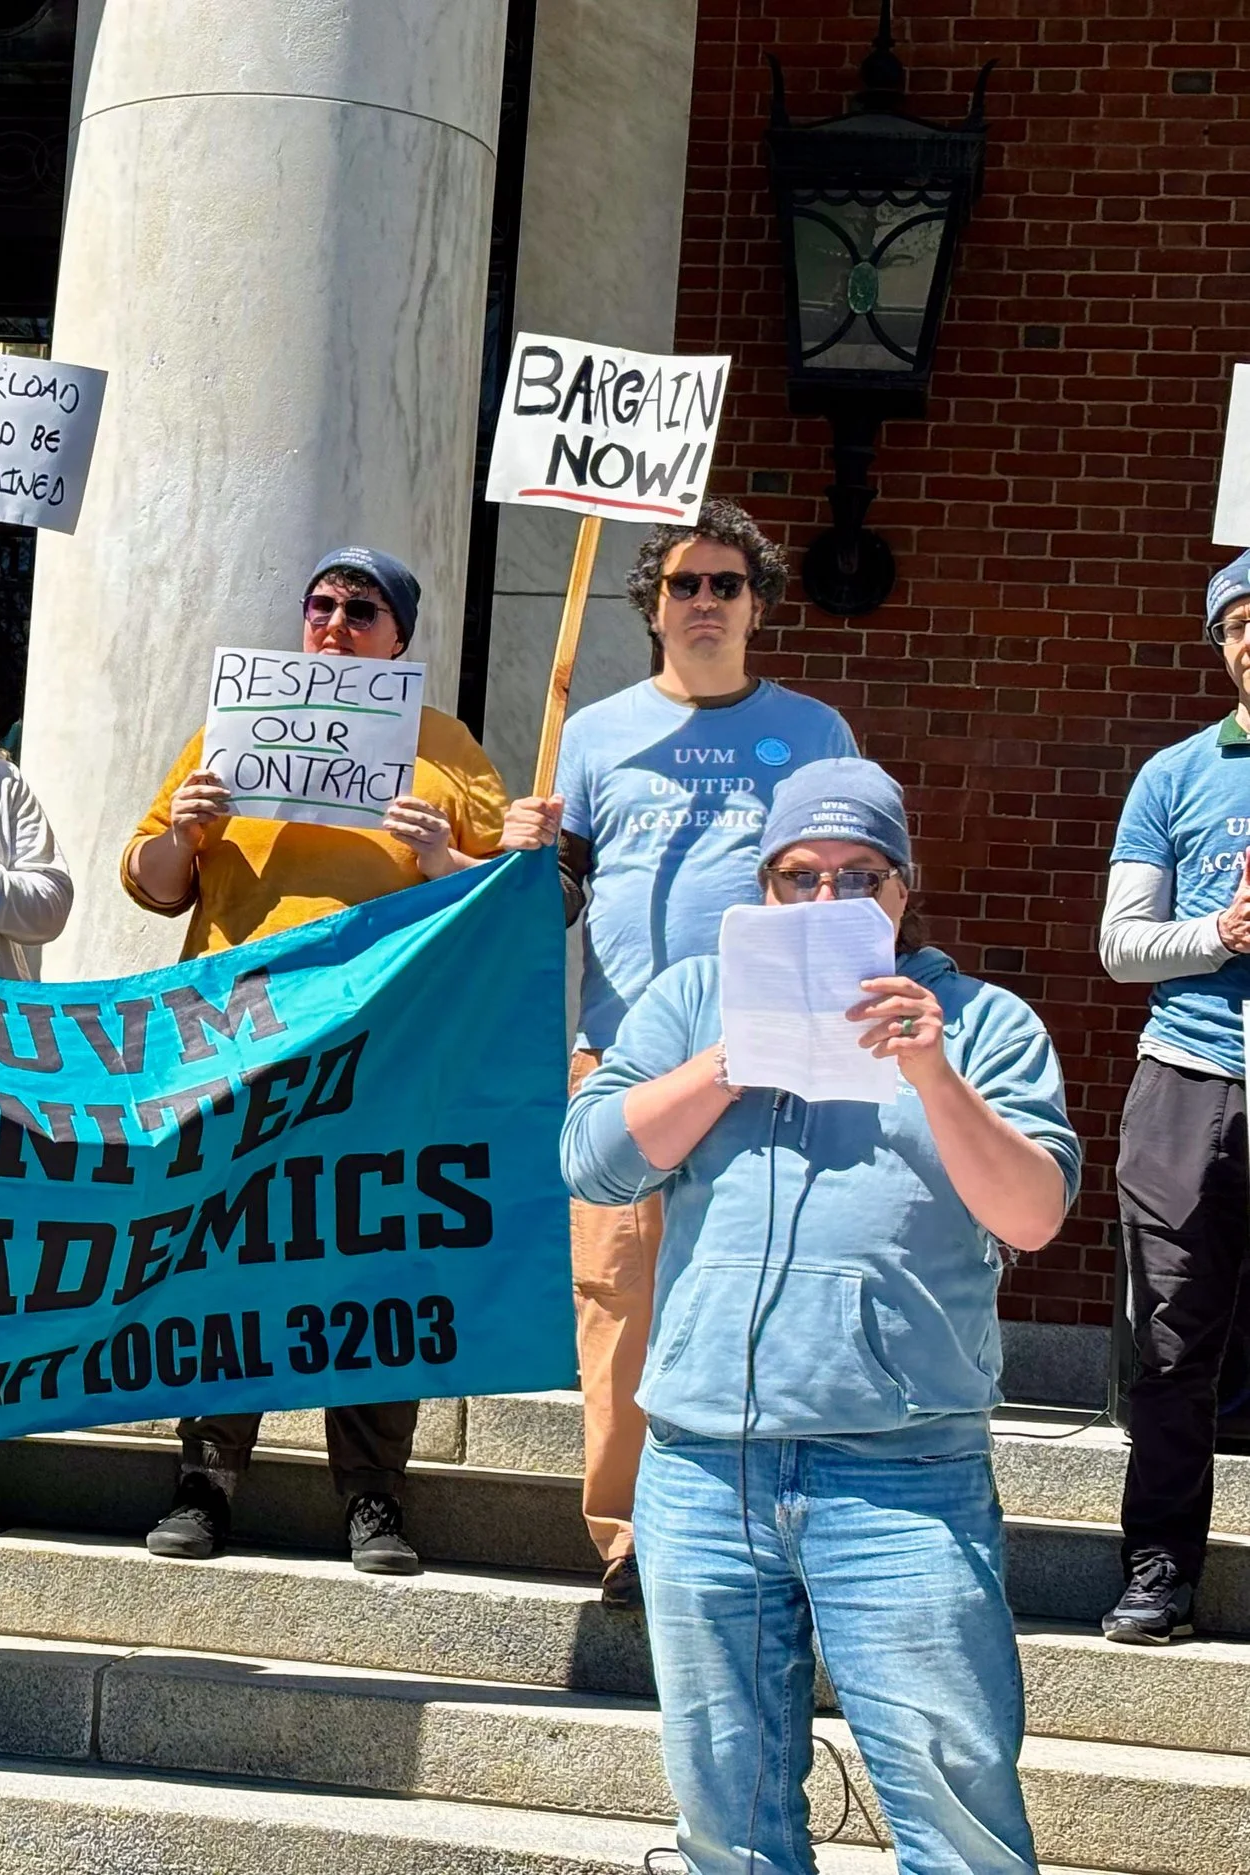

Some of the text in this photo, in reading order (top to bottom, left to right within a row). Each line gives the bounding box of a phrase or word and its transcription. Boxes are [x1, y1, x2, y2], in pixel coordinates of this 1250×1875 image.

[513, 346, 725, 435] BARGAIN
[30, 424, 61, 453] BE
[545, 434, 708, 505] NOW!
[214, 653, 423, 706] RESPECT
[251, 716, 350, 752] OUR
[674, 748, 736, 764] UVM
[649, 777, 756, 796] UNITED
[626, 807, 765, 836] ACADEMIC
[1200, 851, 1247, 875] ACA
[83, 1311, 274, 1395] LOCAL
[286, 1294, 458, 1375] 3203
